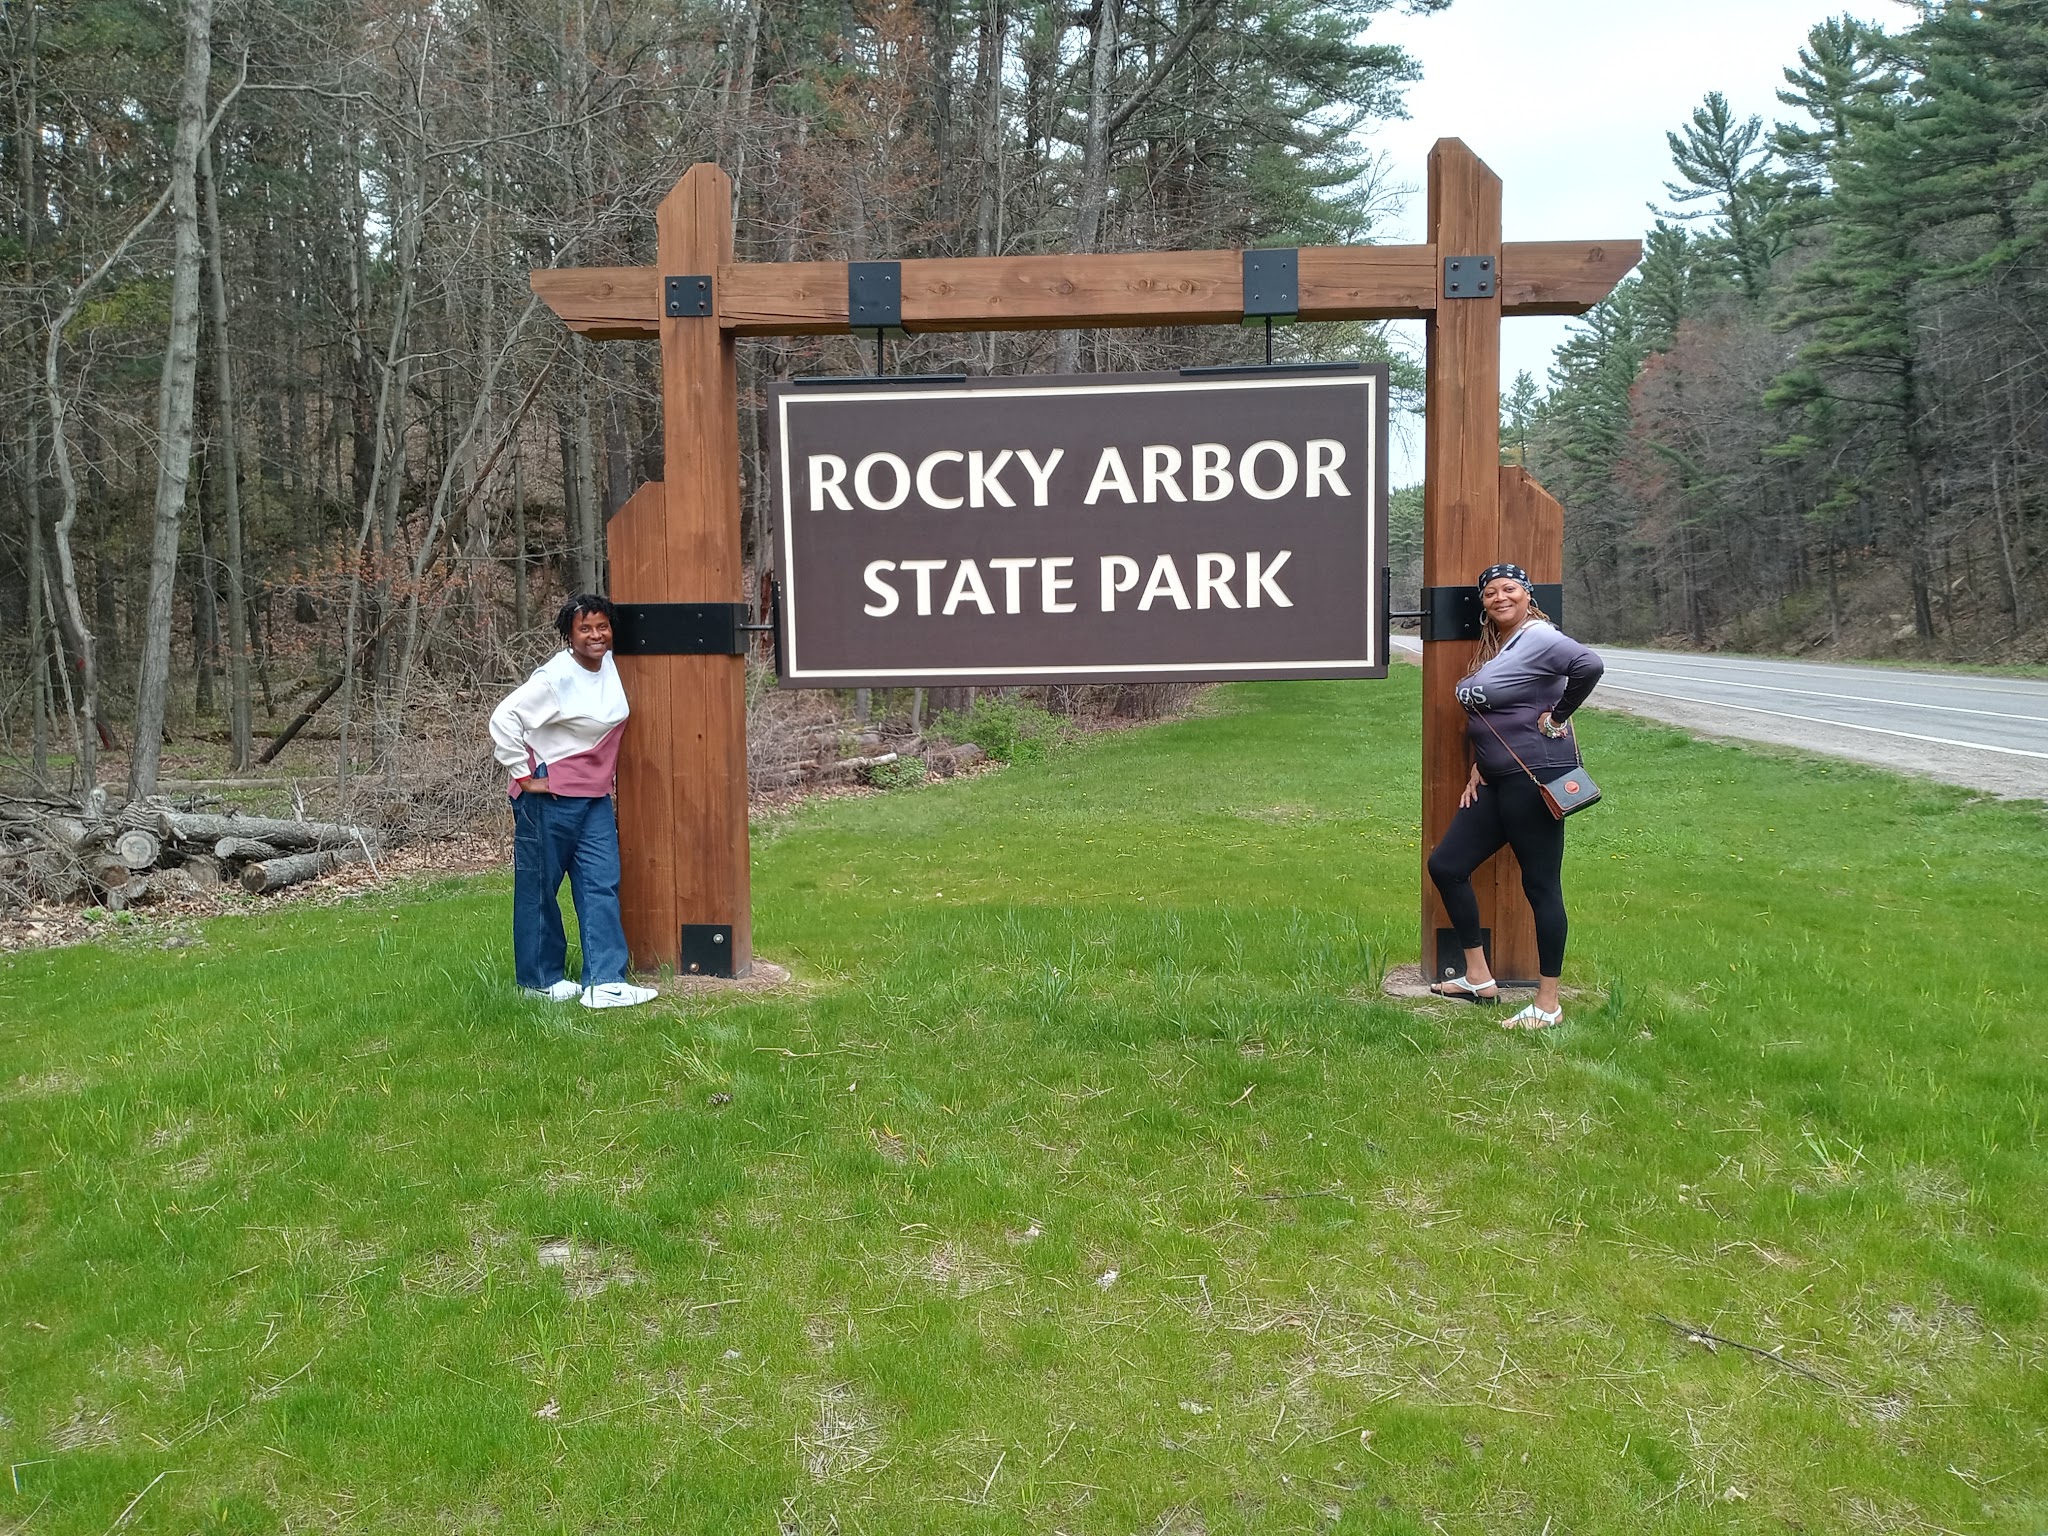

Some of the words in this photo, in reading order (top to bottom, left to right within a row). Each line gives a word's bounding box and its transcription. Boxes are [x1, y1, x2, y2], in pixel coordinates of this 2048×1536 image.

[808, 447, 1065, 512] ROCKY
[1083, 438, 1352, 505] ARBOR
[863, 557, 1078, 618] STATE
[1099, 550, 1295, 613] PARK
